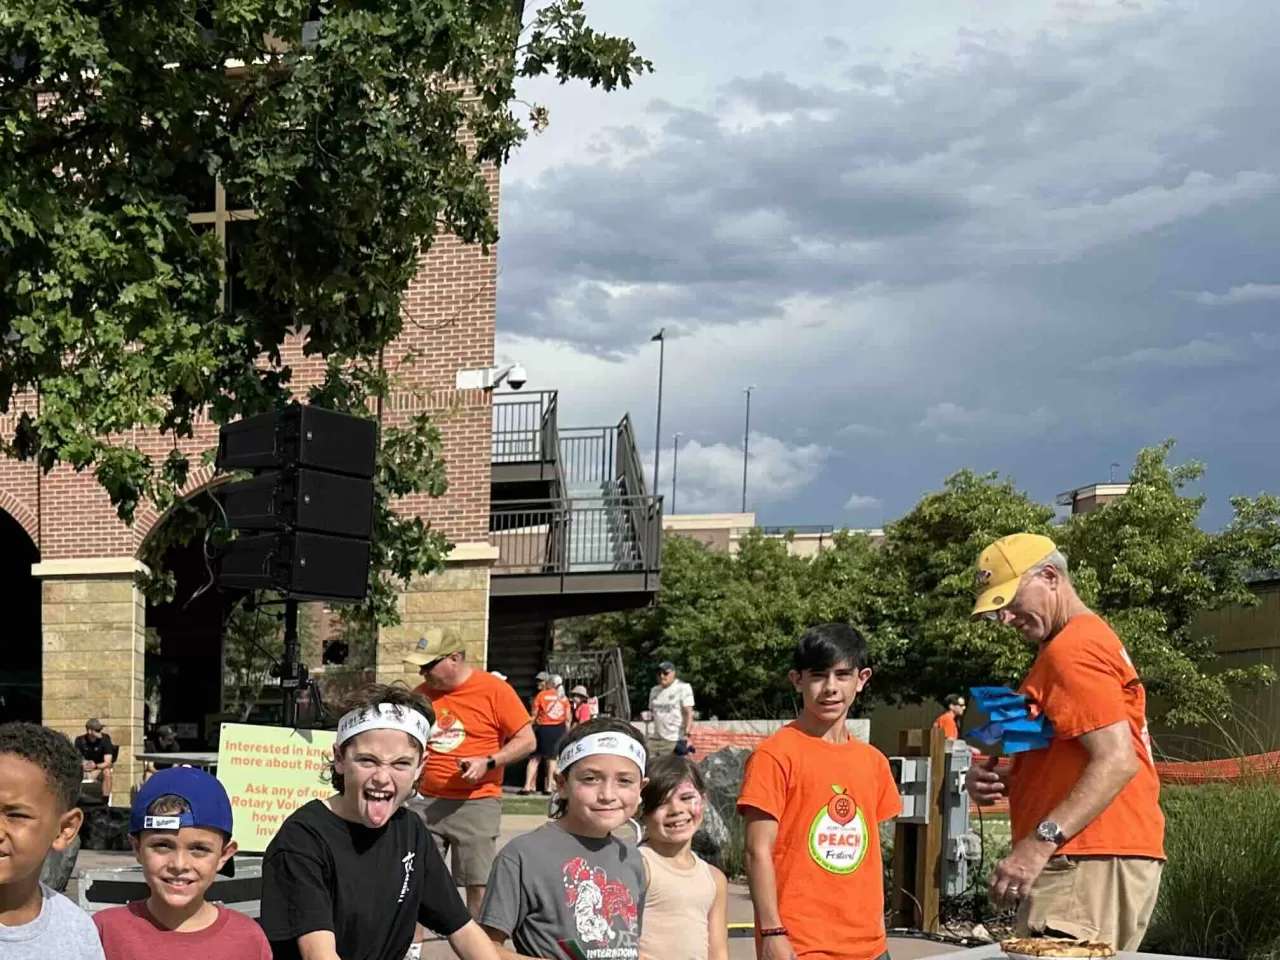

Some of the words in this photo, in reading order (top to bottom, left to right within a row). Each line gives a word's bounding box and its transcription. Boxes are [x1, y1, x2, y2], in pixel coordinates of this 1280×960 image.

[225, 741, 290, 756] Interested
[292, 746, 304, 756] in
[230, 756, 262, 767] more
[265, 758, 302, 770] about
[245, 783, 269, 796] Ask
[271, 787, 294, 799] any
[296, 787, 310, 798] of
[311, 790, 331, 799] our
[231, 796, 273, 812] Rotary
[276, 799, 301, 810] Vol
[252, 811, 278, 823] how
[256, 824, 276, 836] inv
[818, 833, 860, 847] PEACH
